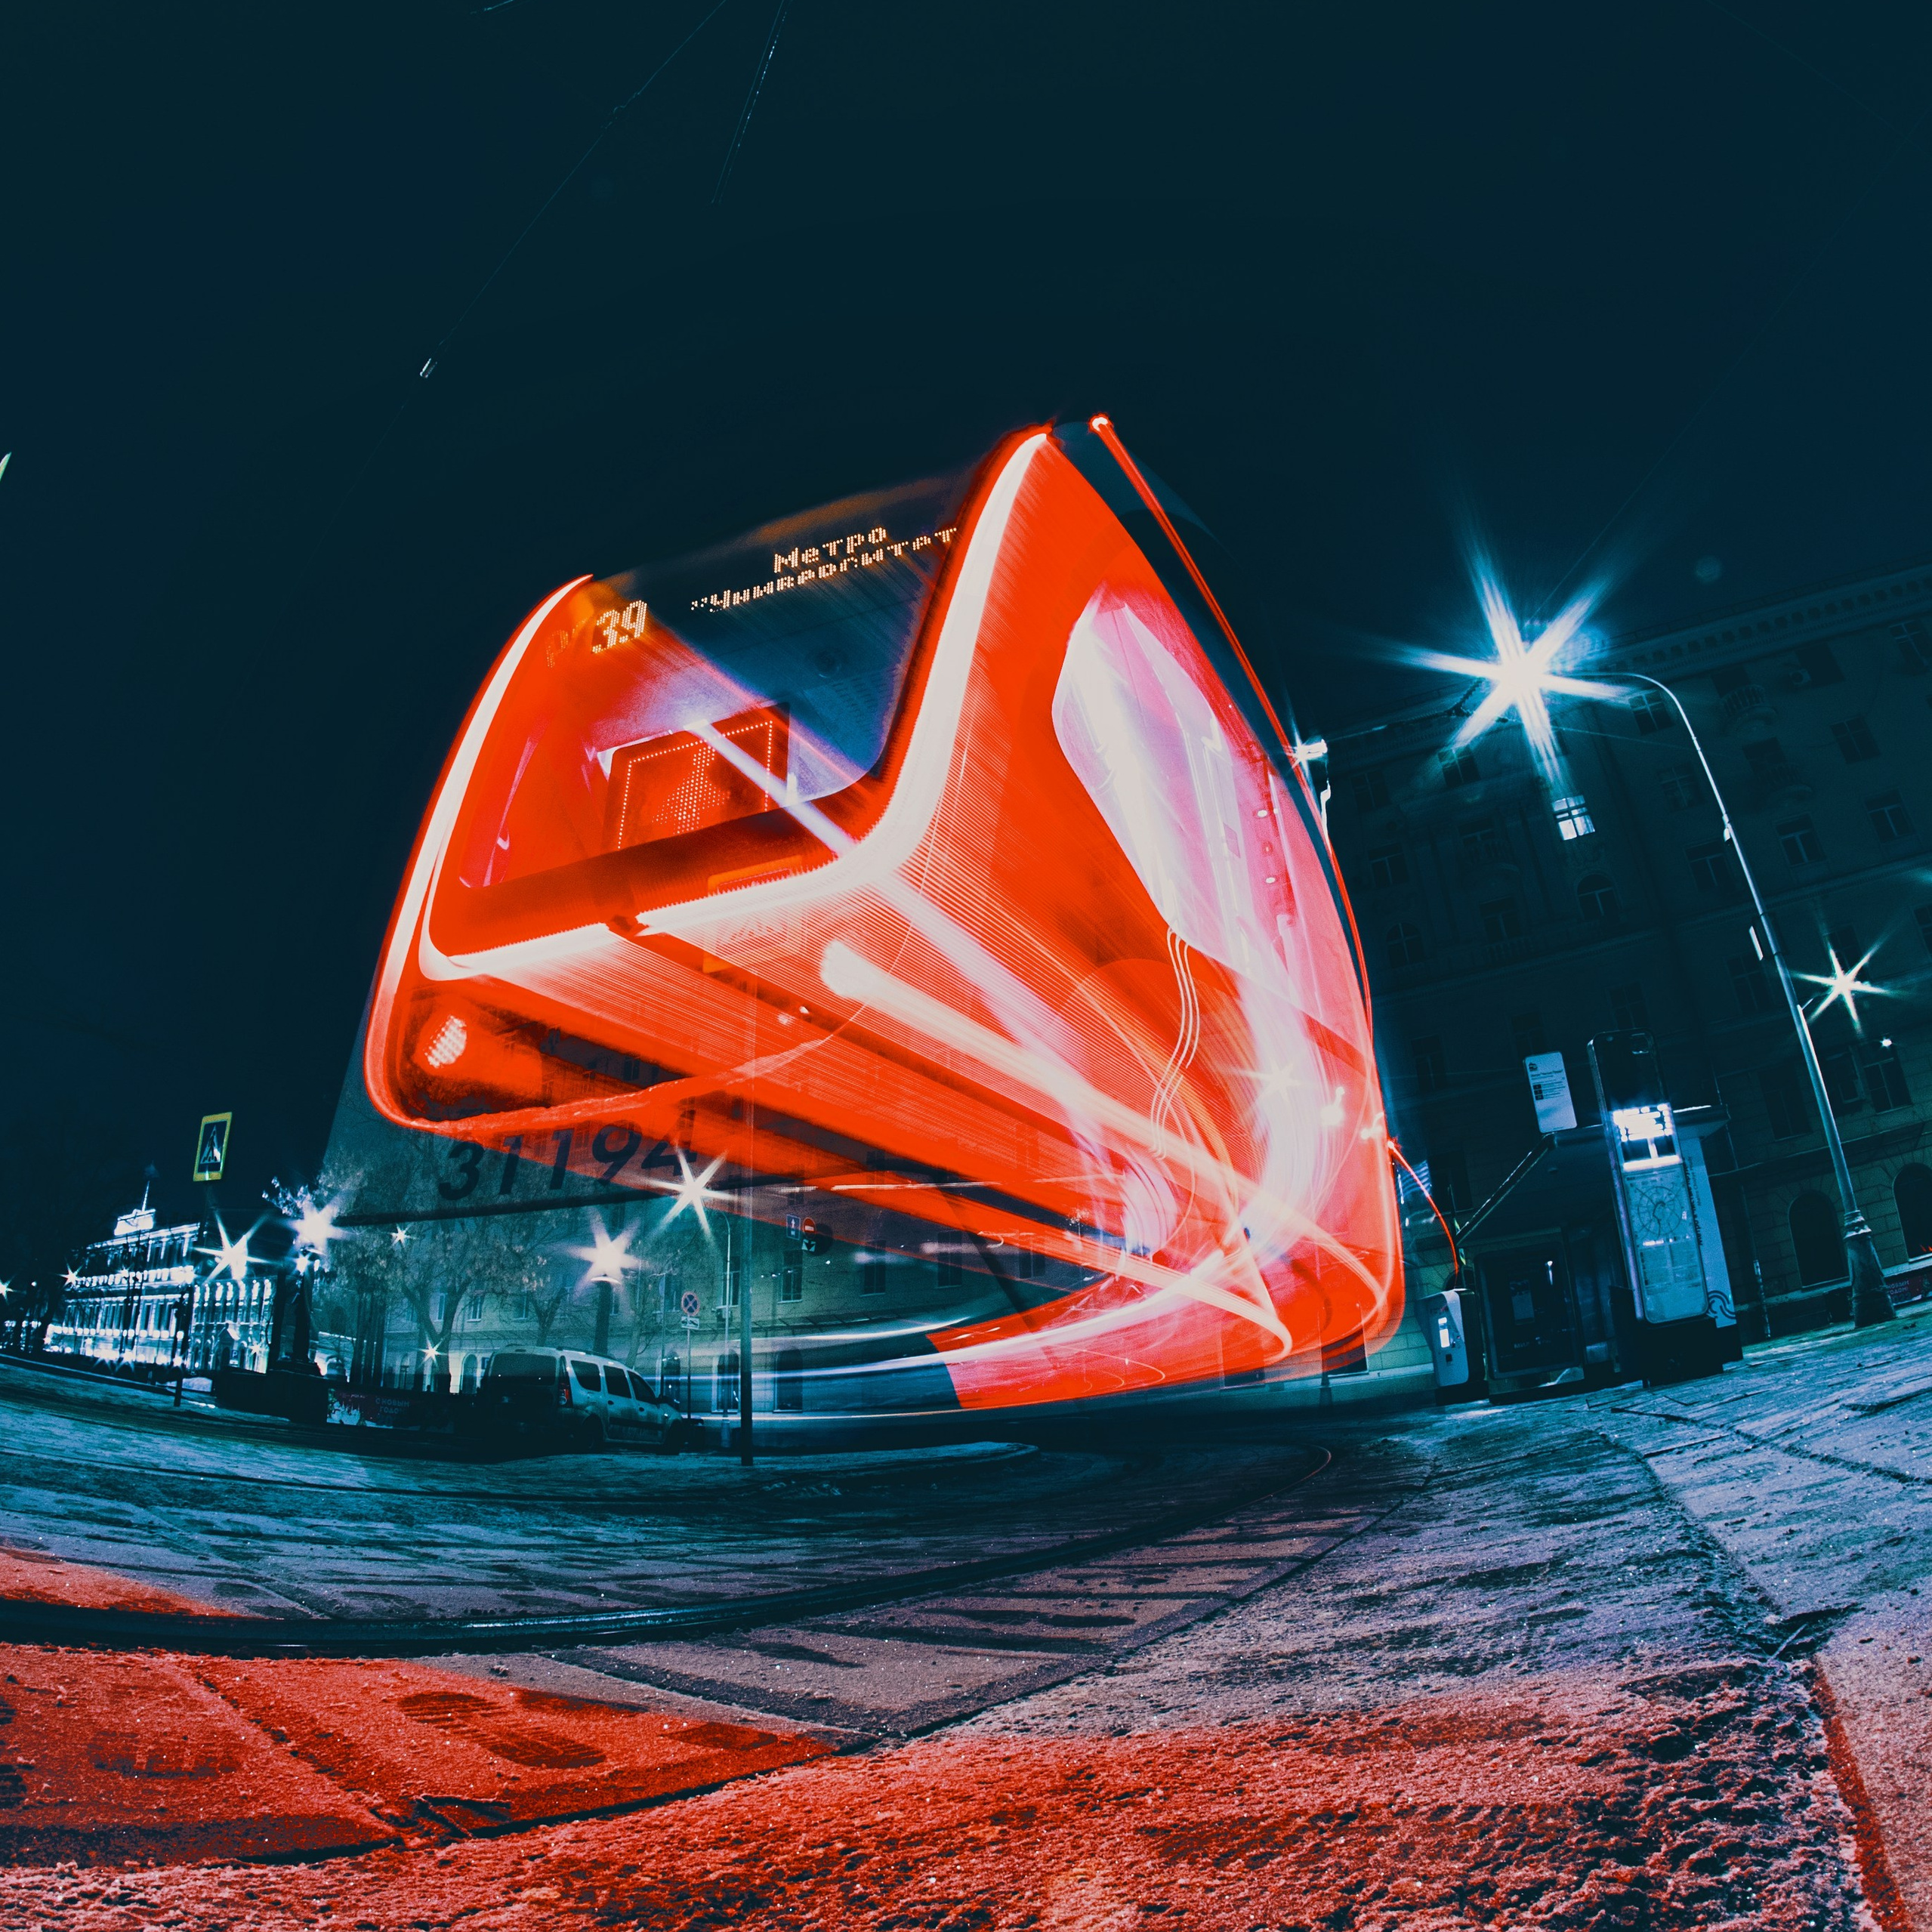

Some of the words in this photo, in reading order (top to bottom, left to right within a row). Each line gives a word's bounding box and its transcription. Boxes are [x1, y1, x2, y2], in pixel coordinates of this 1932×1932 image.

[773, 526, 887, 575] Метро
[591, 600, 648, 654] 39
[438, 1109, 699, 1201] 31194
